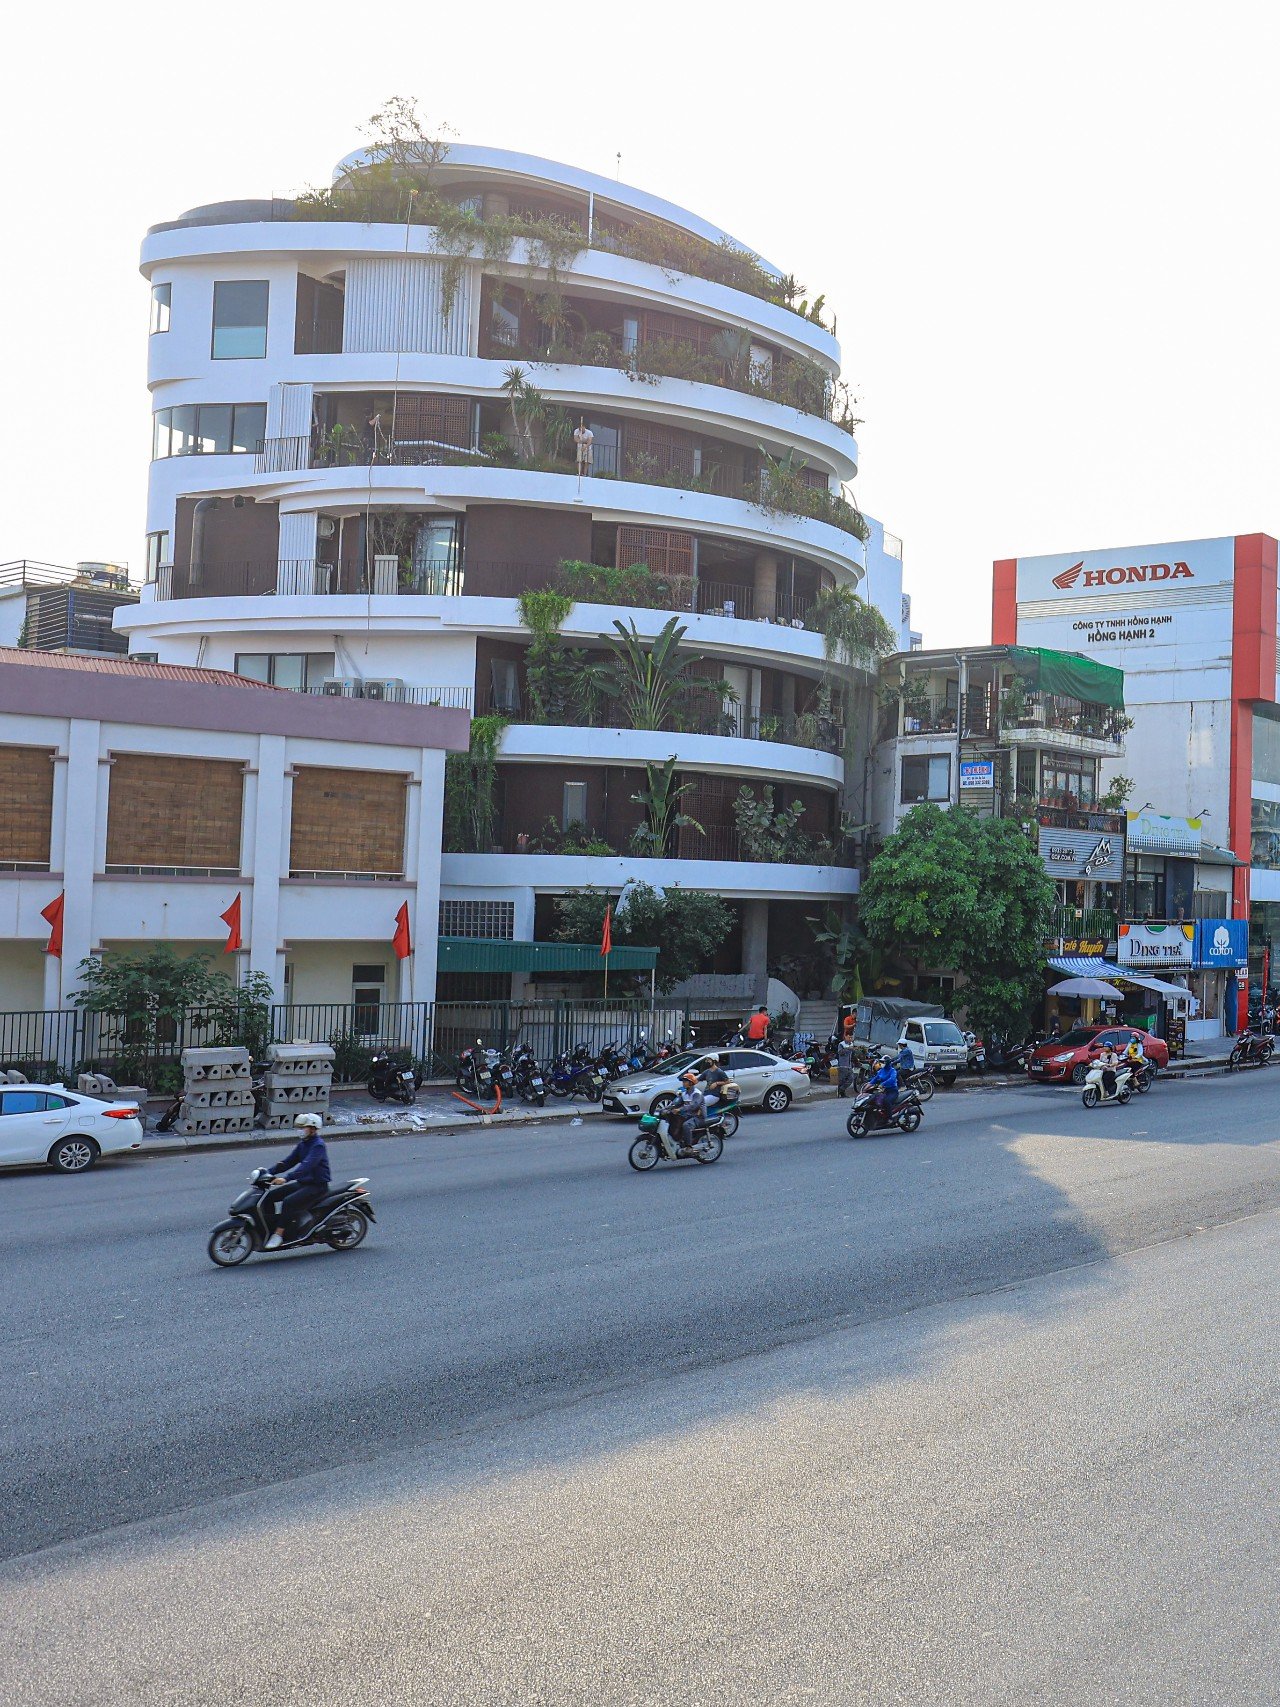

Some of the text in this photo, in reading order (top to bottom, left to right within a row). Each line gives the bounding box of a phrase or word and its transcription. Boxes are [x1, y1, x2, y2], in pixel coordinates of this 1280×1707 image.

[1083, 561, 1195, 587] HONDA
[1072, 615, 1173, 631] CÔNG TY TNHH HỒNG HẠNH
[1087, 628, 1155, 643] HỒNG HẠNH 2
[1063, 939, 1077, 951] afé
[1130, 938, 1182, 957] DING TEA
